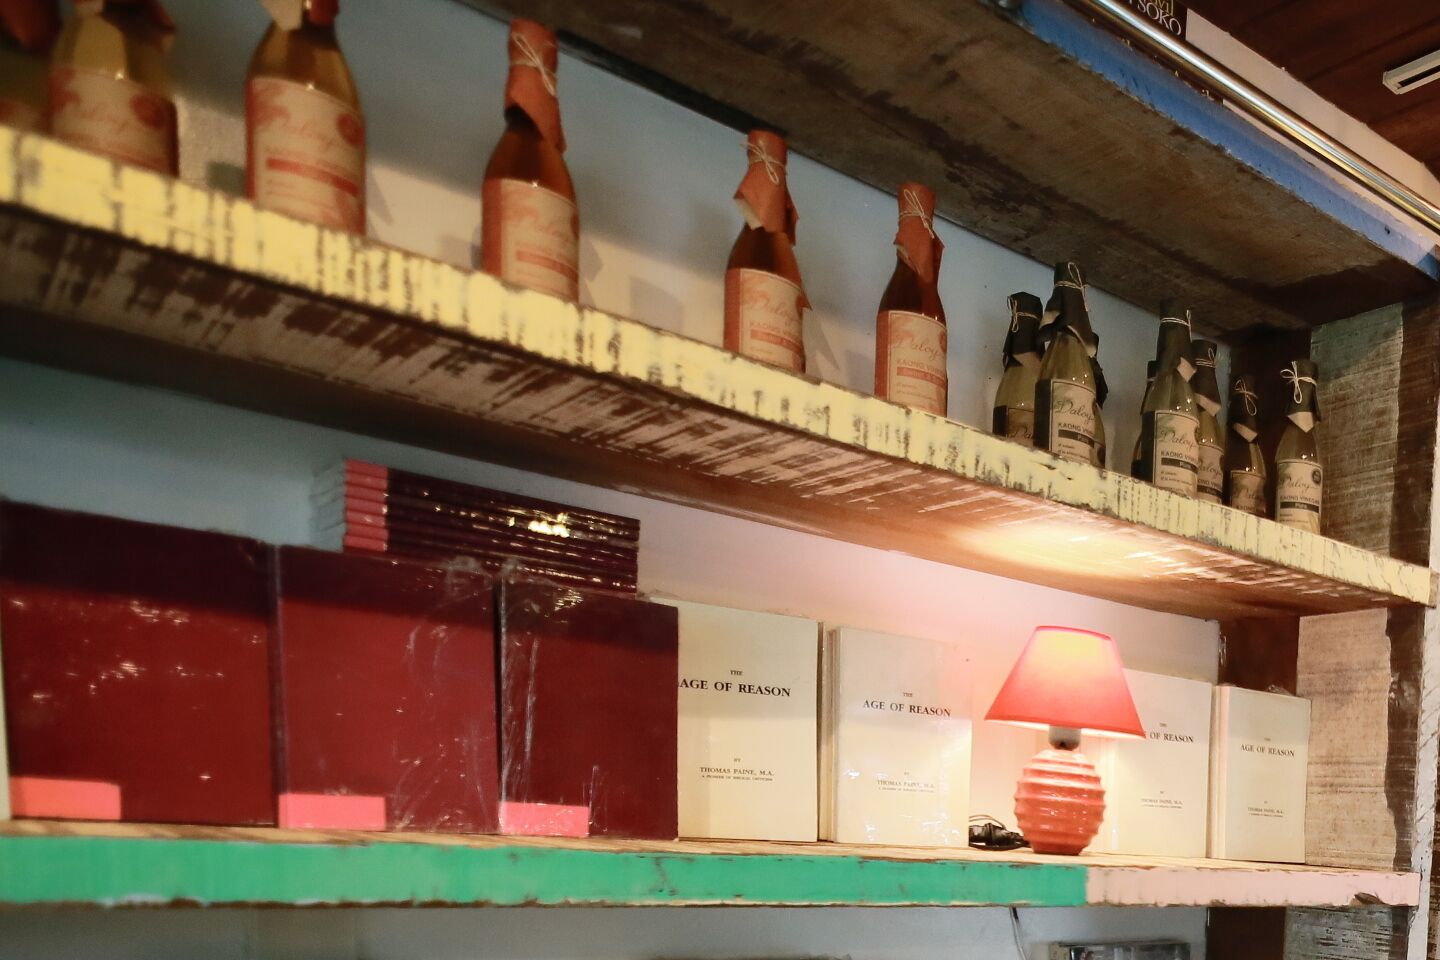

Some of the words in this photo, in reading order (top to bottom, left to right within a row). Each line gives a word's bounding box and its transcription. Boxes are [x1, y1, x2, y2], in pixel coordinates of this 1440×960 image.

[680, 678, 708, 690] AGE
[714, 681, 732, 692] OF
[738, 683, 791, 698] REASON
[863, 700, 886, 710] AGE
[890, 702, 904, 712] OF
[909, 705, 951, 717] REASON
[1164, 733, 1194, 743] REASON
[1241, 744, 1254, 752] AGE
[1257, 745, 1266, 753] OF
[1268, 747, 1295, 757] REASON
